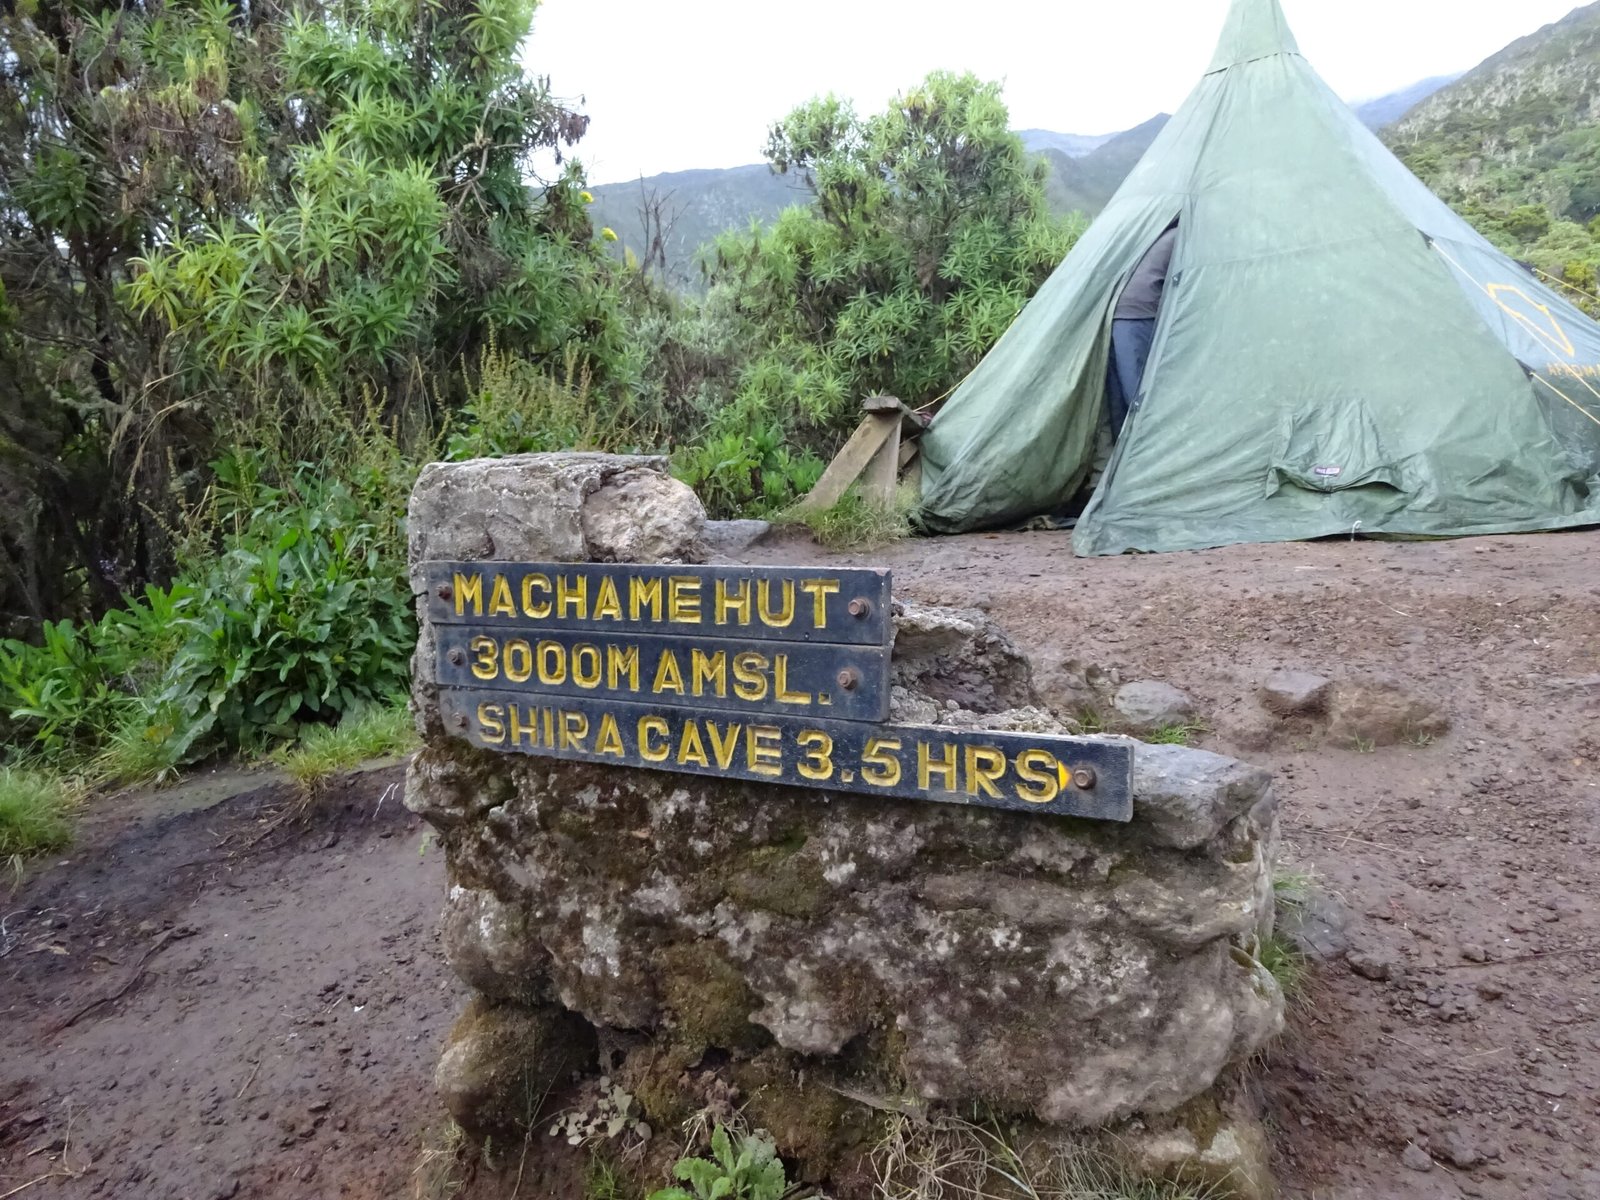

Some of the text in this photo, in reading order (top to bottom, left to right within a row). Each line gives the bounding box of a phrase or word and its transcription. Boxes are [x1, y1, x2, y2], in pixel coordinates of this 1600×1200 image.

[453, 572, 840, 629] MACHAME HUT
[470, 635, 832, 705] 3000M AMSL.
[477, 702, 1060, 803] SHIRA CAVE 3.5 HRS
